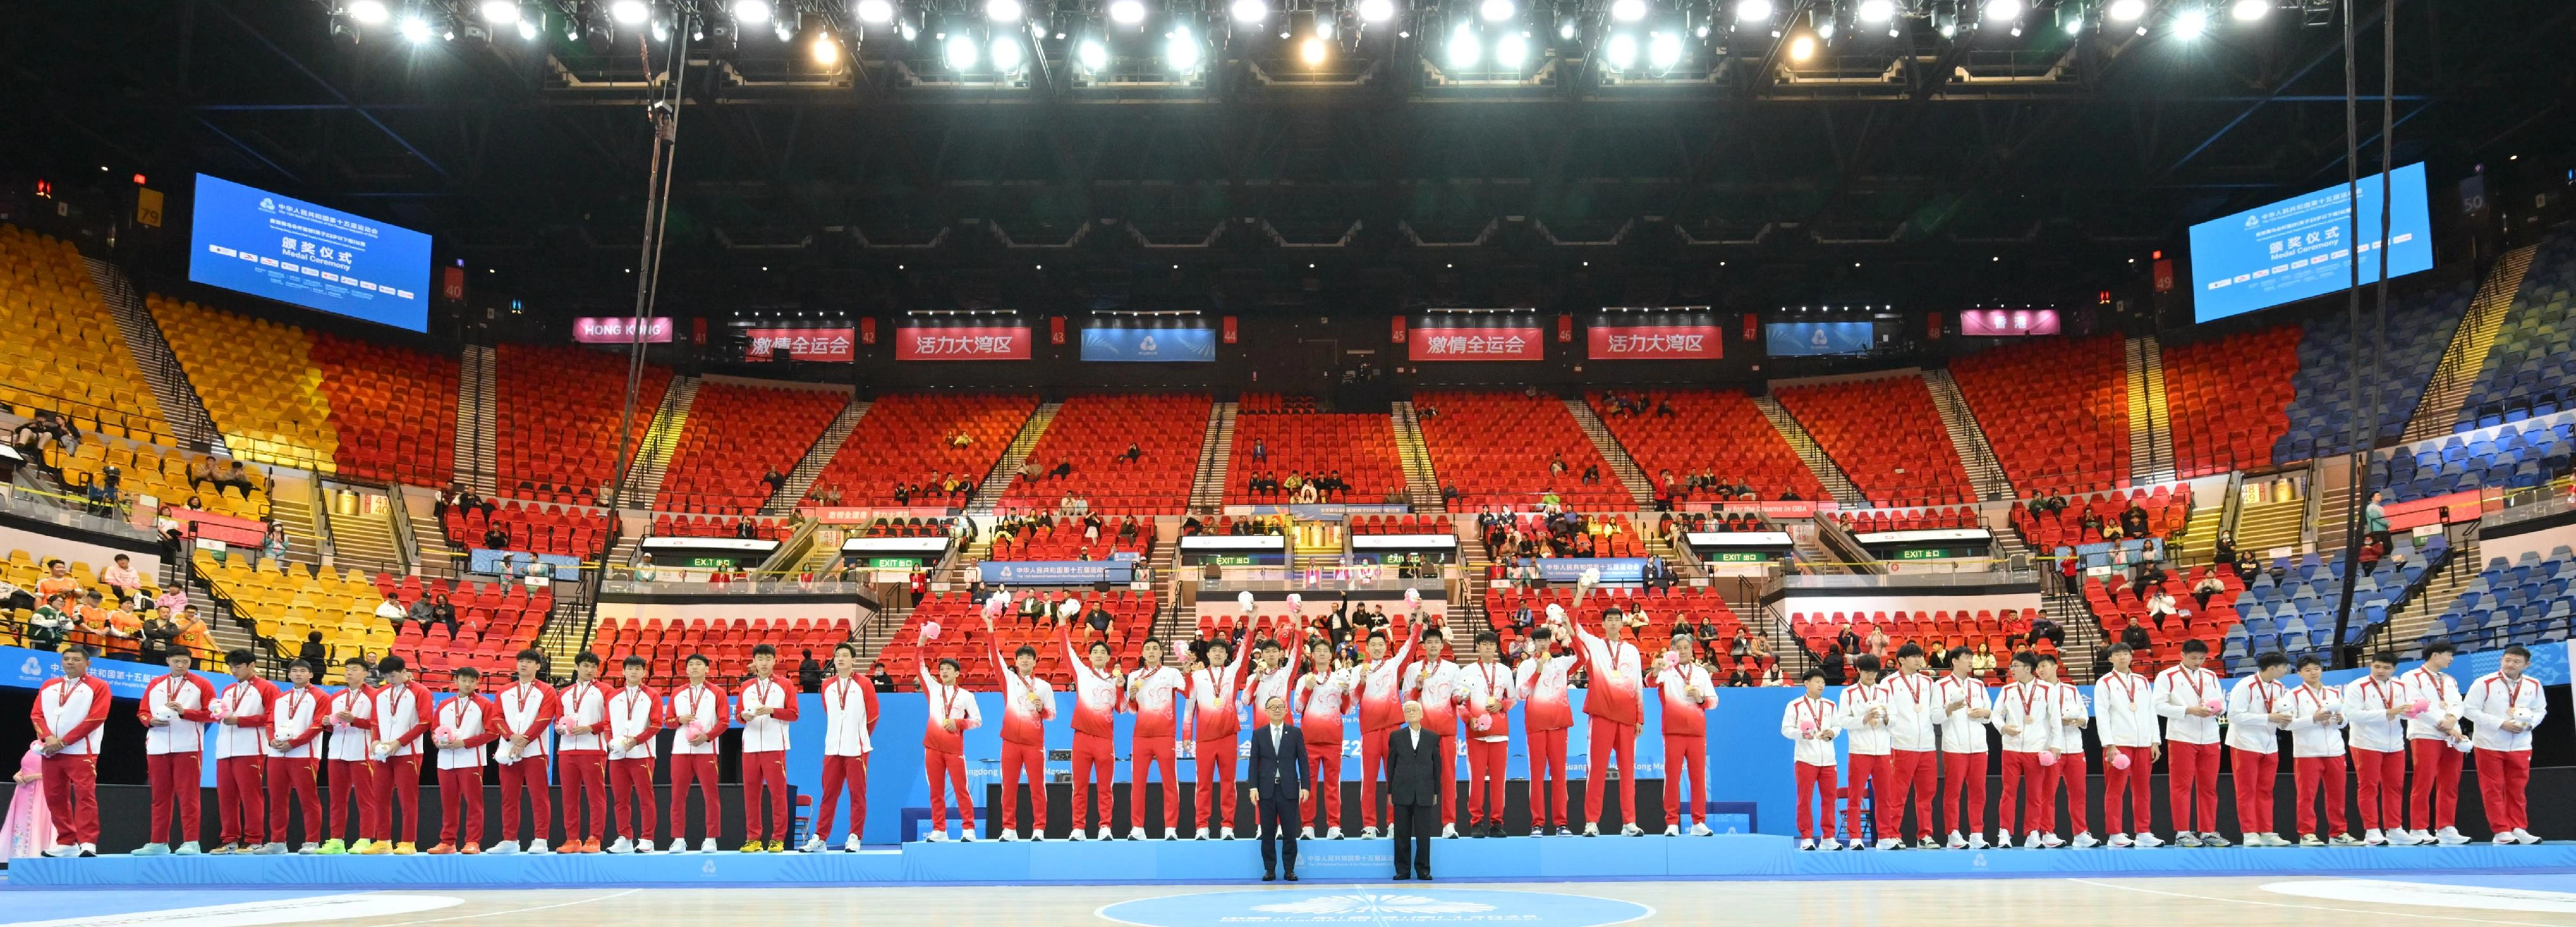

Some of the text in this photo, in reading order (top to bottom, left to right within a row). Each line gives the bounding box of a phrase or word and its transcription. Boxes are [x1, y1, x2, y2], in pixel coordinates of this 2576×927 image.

[2464, 195, 2483, 211] 50
[142, 207, 158, 224] 79
[2269, 225, 2340, 254] 颁奖仪式
[281, 236, 353, 264] 颁奖仪式
[2271, 249, 2296, 260] Medal
[2297, 239, 2339, 254] Ceremony
[282, 249, 308, 260] Medal
[310, 255, 350, 271] Ceremony
[2157, 276, 2172, 289] 49
[446, 285, 461, 298] 40
[1994, 315, 2027, 329] 香港
[585, 325, 621, 336] HONG
[1225, 331, 1236, 341] 44
[1393, 330, 1404, 341] 45
[1560, 330, 1571, 340] 46
[1745, 329, 1756, 339] 47
[696, 333, 706, 343] 41
[863, 332, 875, 343] 42
[1053, 332, 1064, 343] 43
[1607, 334, 1703, 352] 活力大湾区
[751, 336, 850, 355] 激情全运会
[914, 336, 1012, 354] 活力大湾区
[1426, 335, 1526, 354] 激情全运会
[375, 497, 388, 506] 41
[375, 506, 389, 515] 40
[1566, 763, 1587, 771] Guang
